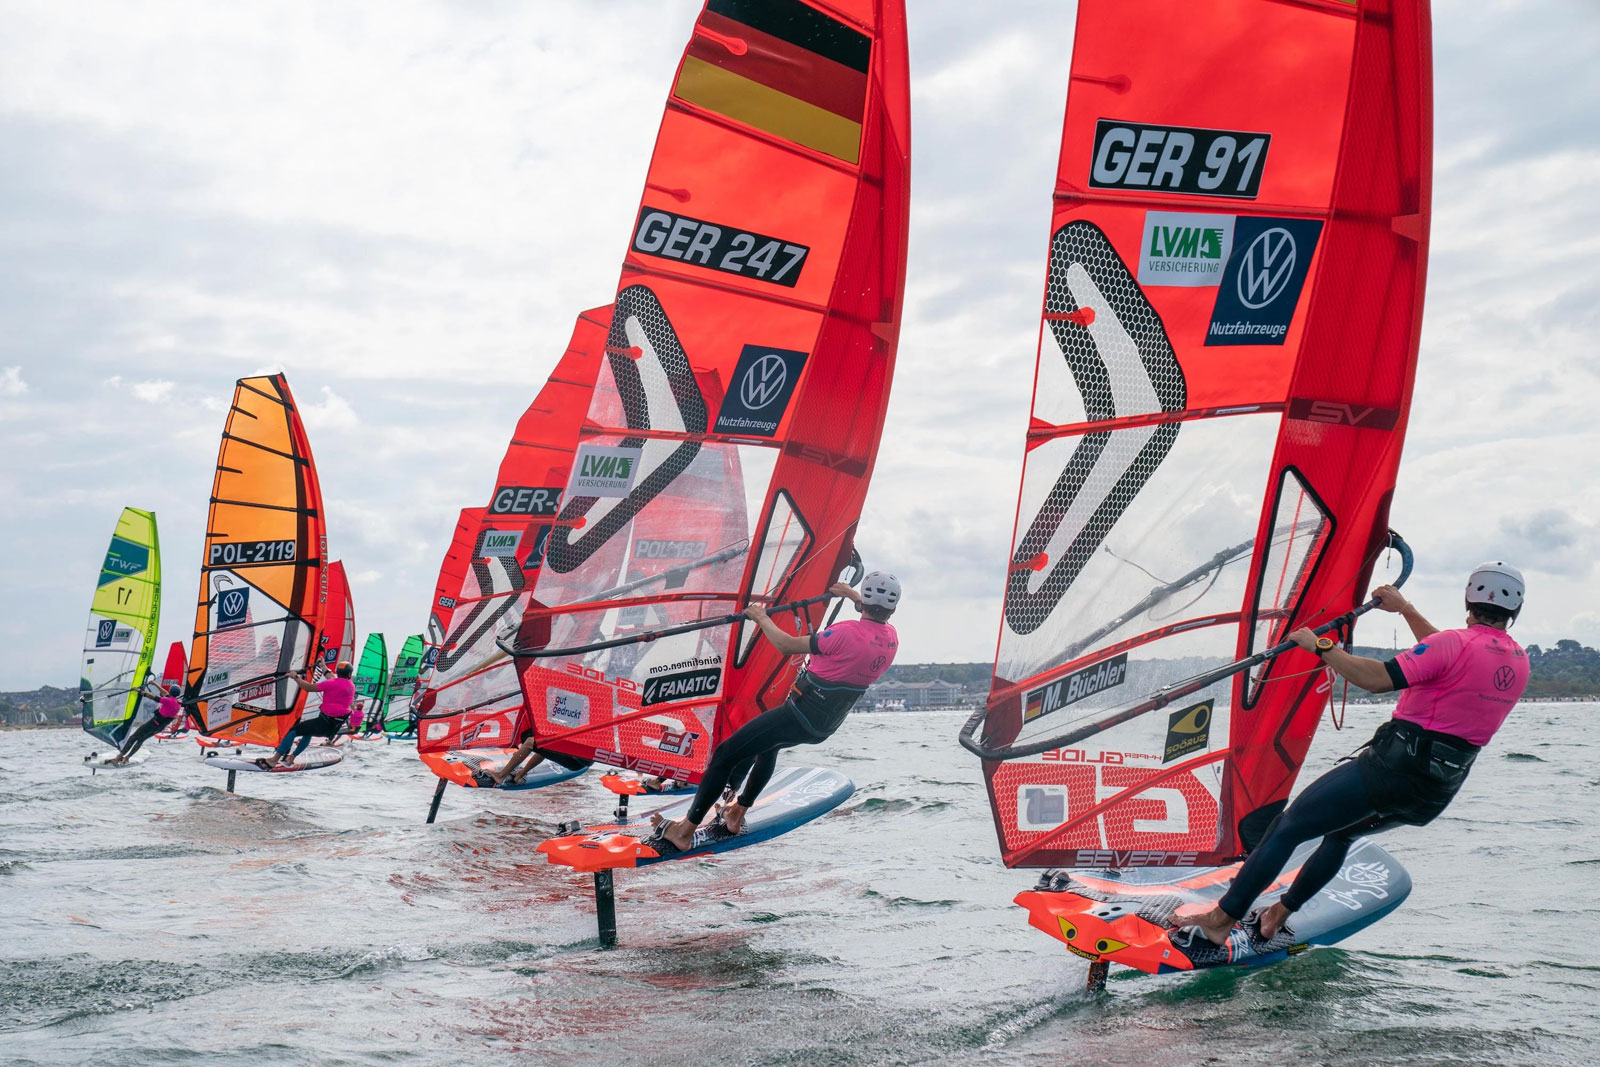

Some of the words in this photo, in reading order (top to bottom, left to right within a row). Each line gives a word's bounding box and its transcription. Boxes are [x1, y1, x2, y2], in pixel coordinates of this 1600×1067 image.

[1093, 127, 1195, 188] GER
[1197, 135, 1266, 192] 91
[635, 212, 722, 264] GER
[719, 233, 807, 281] 247
[1150, 225, 1203, 259] LVM
[1149, 260, 1220, 273] VERSICHERUNG
[1209, 321, 1287, 338] Nutzfahrzeuge
[717, 416, 777, 431] Nutzfahrzeuge
[580, 455, 619, 479] LVM
[578, 479, 628, 489] VERSICHERUNG
[486, 535, 508, 548] LVM
[210, 541, 295, 565] POL-2119
[658, 675, 717, 698] FANATIC
[1041, 685, 1061, 714] M.
[1065, 661, 1126, 704] Büchler
[555, 695, 567, 707] gut
[552, 705, 581, 720] gedruckt
[593, 748, 692, 782] SEVERNE
[1074, 850, 1199, 866] SEVERNE
